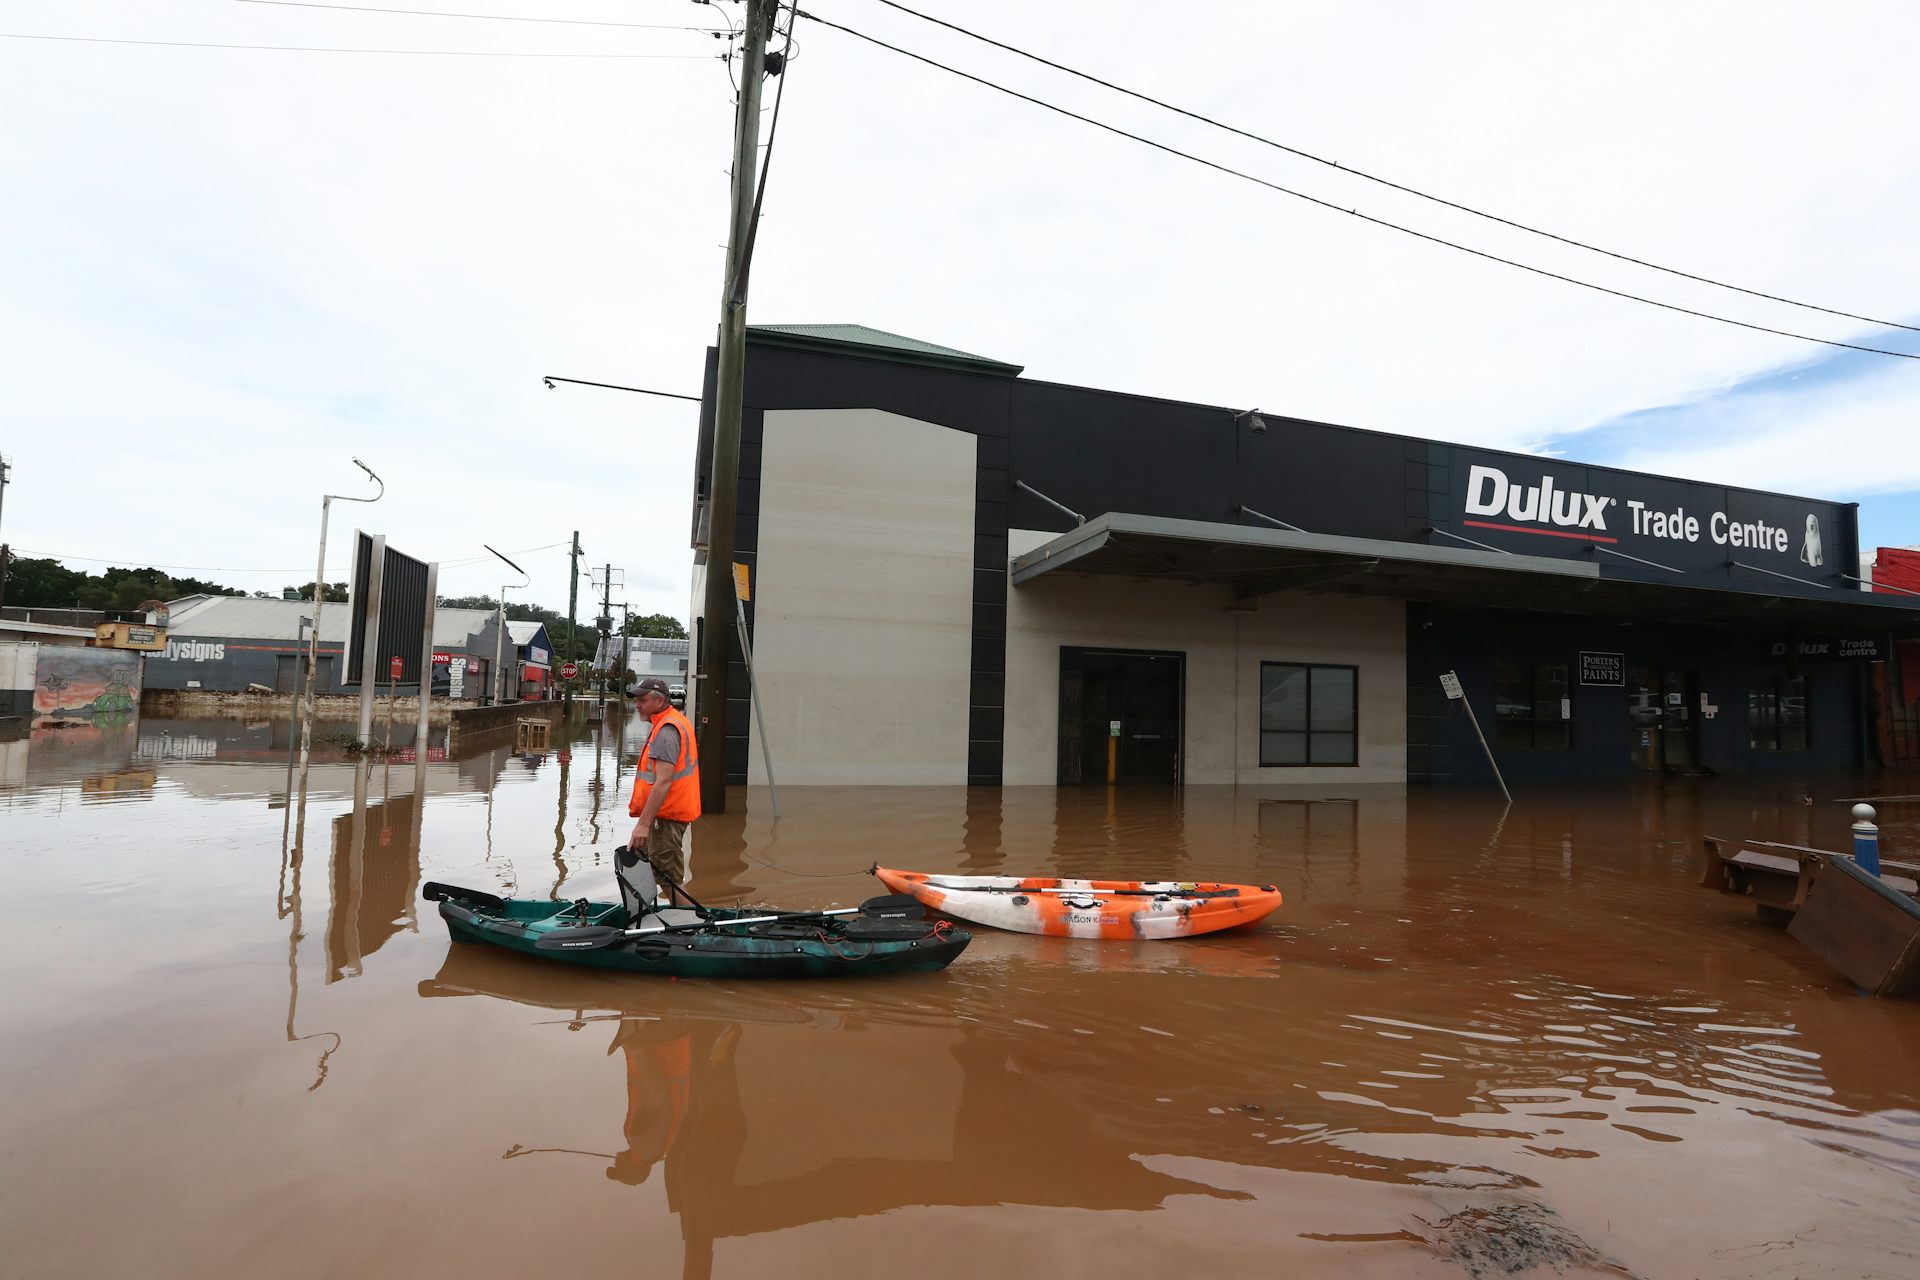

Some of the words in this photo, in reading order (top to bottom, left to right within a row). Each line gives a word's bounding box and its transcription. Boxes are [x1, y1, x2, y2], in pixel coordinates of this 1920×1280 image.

[1465, 464, 1611, 530] Dulux
[1627, 499, 1700, 543] Trade
[1710, 512, 1788, 552] Centre
[1772, 642, 1830, 656] Dlux
[1840, 640, 1875, 648] Trade
[1839, 648, 1878, 656] centre
[1583, 655, 1620, 669] PORTERS
[562, 667, 576, 675] STOP
[1583, 669, 1620, 681] PAINTS
[1441, 675, 1454, 684] 2P
[1058, 915, 1092, 924] DRAGON
